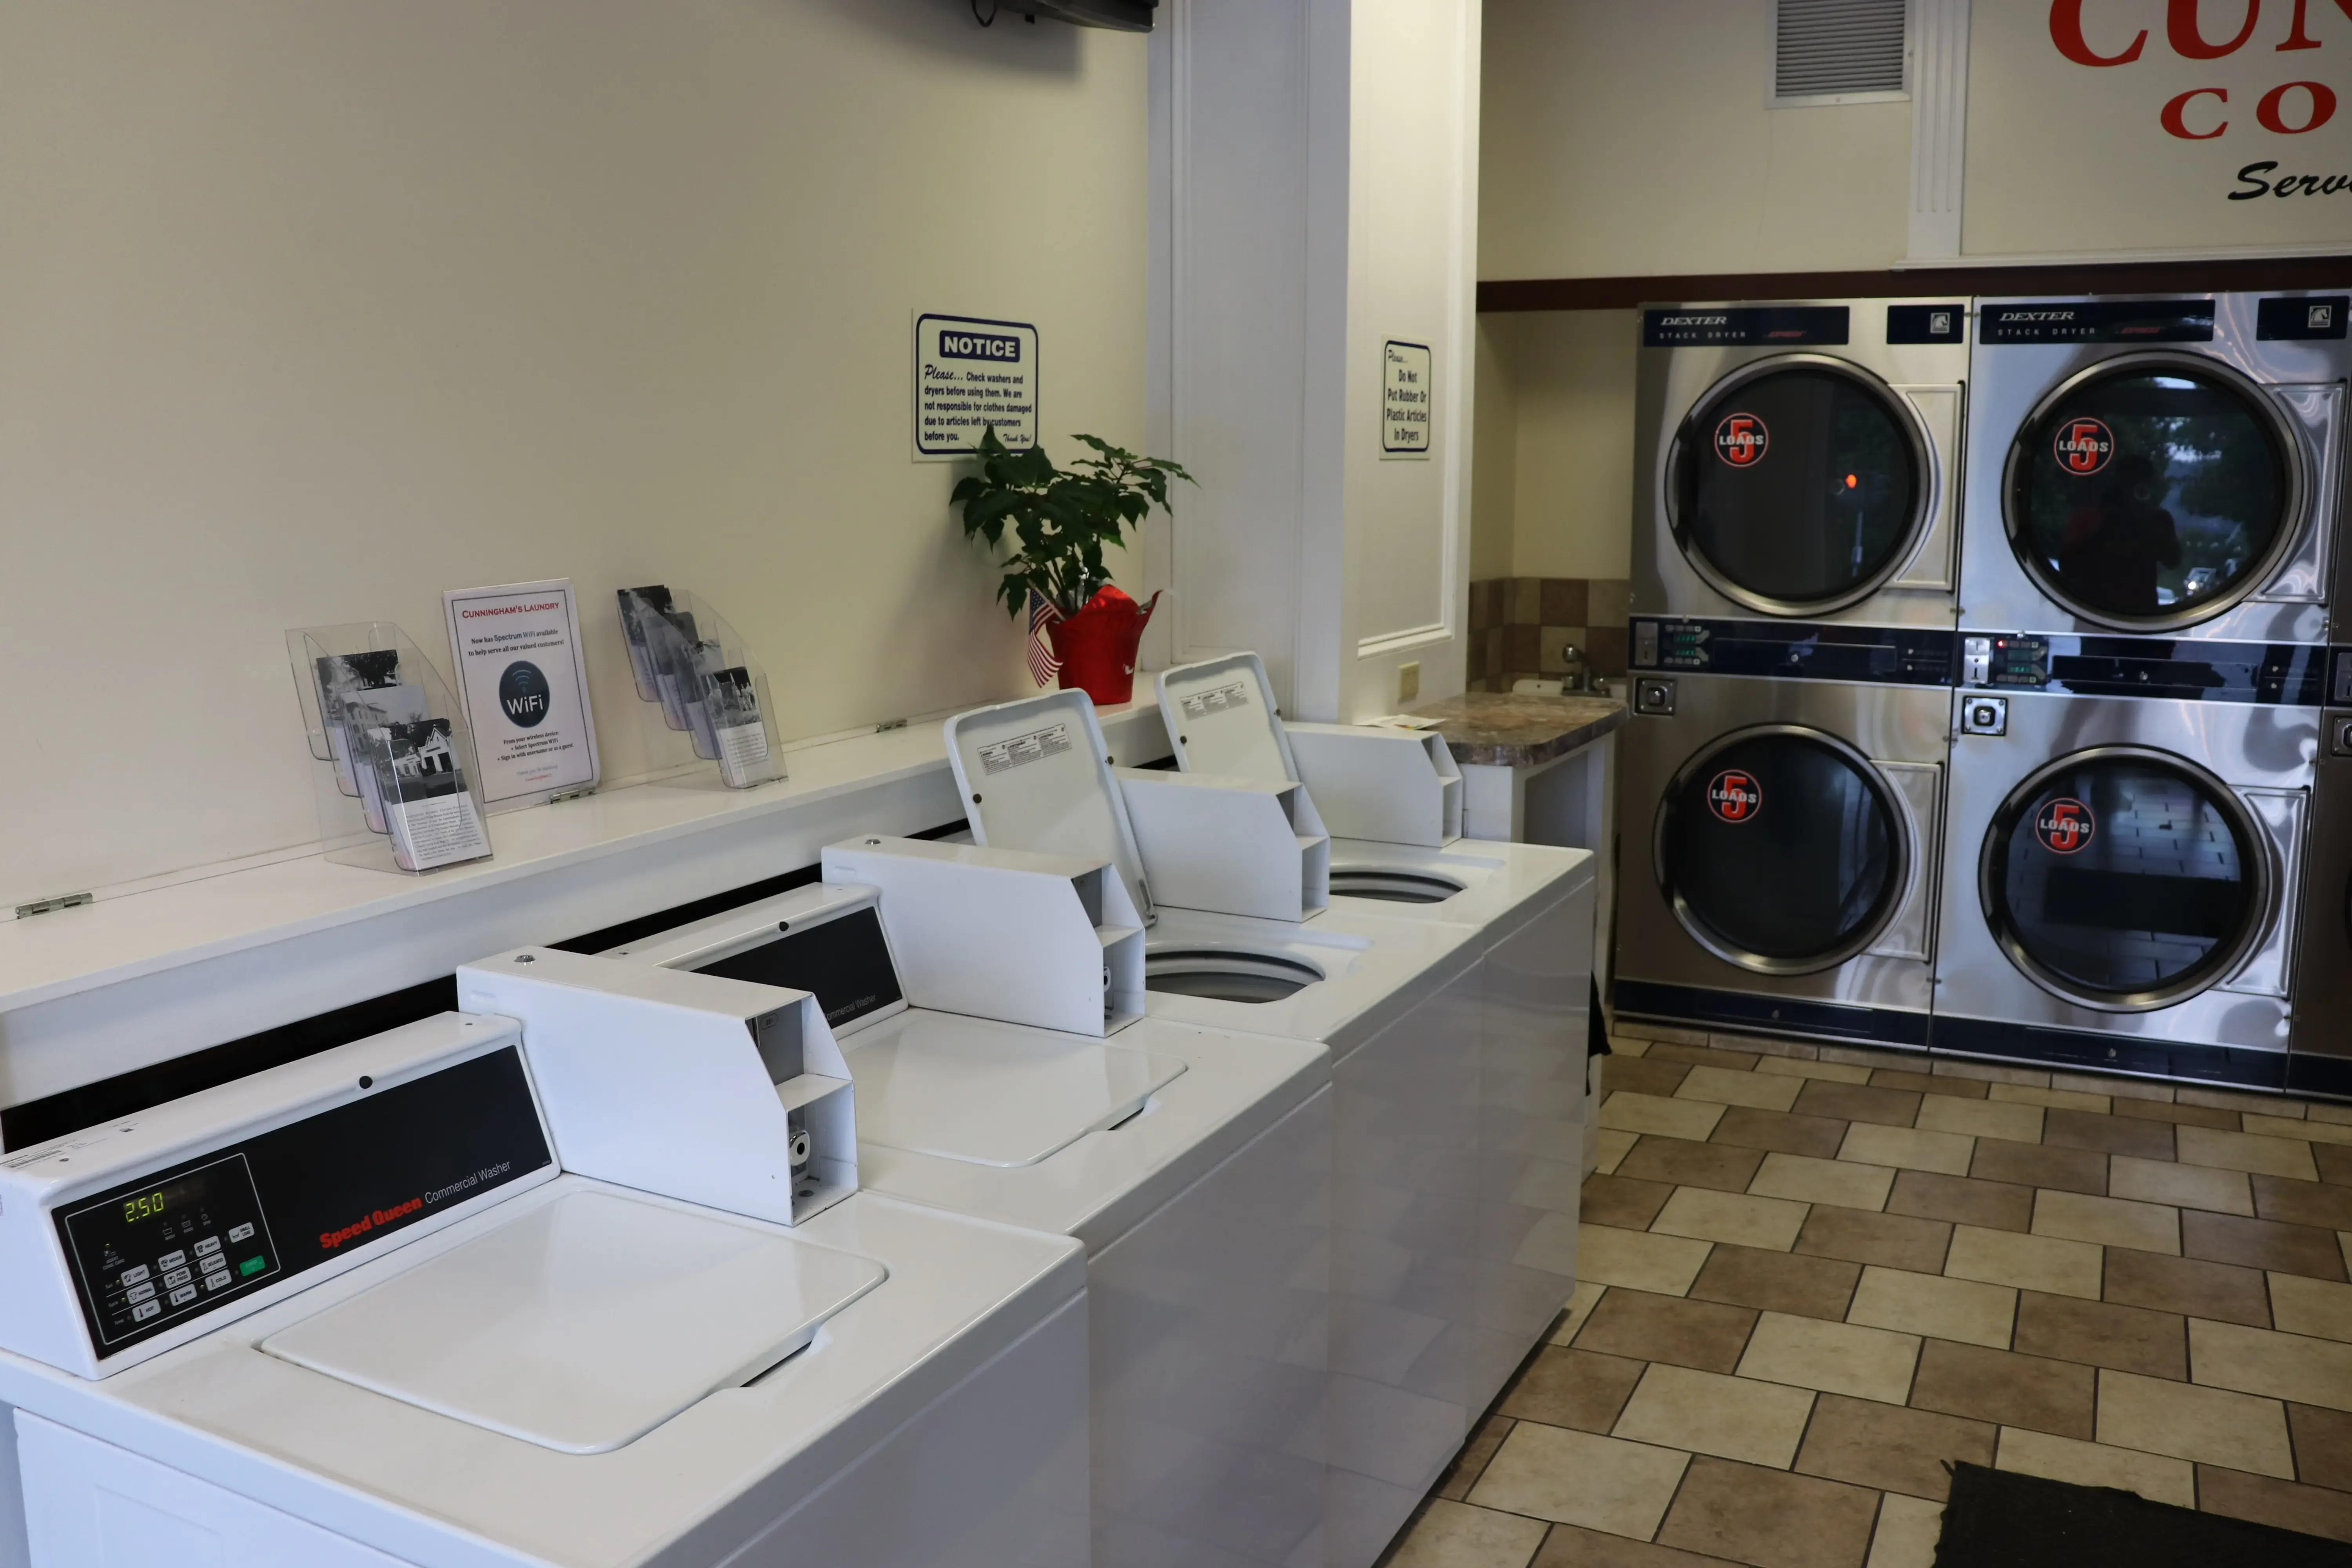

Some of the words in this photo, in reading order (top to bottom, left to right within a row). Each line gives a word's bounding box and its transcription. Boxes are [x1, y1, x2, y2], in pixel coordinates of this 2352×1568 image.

[2228, 161, 2352, 200] Serv
[1661, 316, 1727, 326] DEXTER
[2000, 311, 2074, 321] DEXTER
[944, 336, 1016, 358] NOTICE
[924, 364, 963, 380] Please...
[967, 371, 985, 382] Check
[987, 373, 1011, 384] washers
[1013, 375, 1023, 384] and
[1399, 369, 1406, 382] Do
[1407, 370, 1417, 383] Not
[925, 385, 944, 397] dryers
[946, 386, 965, 396] before
[967, 387, 984, 398] using
[985, 388, 1002, 398] them.
[1003, 388, 1013, 398] We
[1388, 388, 1397, 401] Put
[1399, 389, 1418, 403] Rubber
[1420, 391, 1427, 403] Or
[925, 401, 935, 410] not
[936, 401, 971, 413] responsible
[973, 402, 982, 411] for
[984, 402, 1005, 412] clothes
[1006, 403, 1032, 414] damaged
[1387, 407, 1405, 421] Plastic
[1406, 409, 1427, 422] Articles
[925, 416, 936, 426] due
[938, 417, 944, 426] to
[946, 416, 969, 426] articles
[971, 416, 981, 426] left
[992, 417, 1021, 427] customers
[925, 431, 944, 441] before
[946, 433, 959, 443] you.
[1003, 433, 1018, 442] Thank
[1020, 434, 1031, 444] You!
[1394, 428, 1399, 441] In
[1401, 428, 1419, 444] Dryers
[1719, 435, 1764, 445] LOADS
[1730, 419, 1754, 463] 5
[2059, 440, 2109, 452] LOADS
[2069, 424, 2098, 470] 5
[462, 606, 523, 619] CUNNINGHAM'S
[524, 602, 559, 612] LAUNDRY
[494, 633, 522, 642] Spectrum
[536, 628, 558, 637] available
[475, 648, 487, 656] help
[520, 642, 536, 650] valued
[537, 639, 564, 648] customers!
[506, 694, 543, 715] WiFi
[1711, 789, 1757, 804] LOADS
[1721, 775, 1748, 818] 5
[2040, 818, 2090, 834] LOADS
[2051, 804, 2080, 851] 5
[855, 994, 876, 1009] Washer
[125, 1192, 164, 1222] 2.50
[319, 1216, 372, 1249] Speed
[372, 1197, 422, 1226] Queen
[425, 1172, 478, 1204] Commercial
[477, 1161, 510, 1181] Washer
[205, 1241, 218, 1249] HEAVY
[169, 1255, 183, 1263] MEDIUM
[133, 1269, 145, 1278] LIGHT
[177, 1274, 189, 1282] PRESS
[216, 1275, 227, 1283] COLD
[138, 1287, 153, 1296] NORMAL
[180, 1290, 192, 1298] WARM
